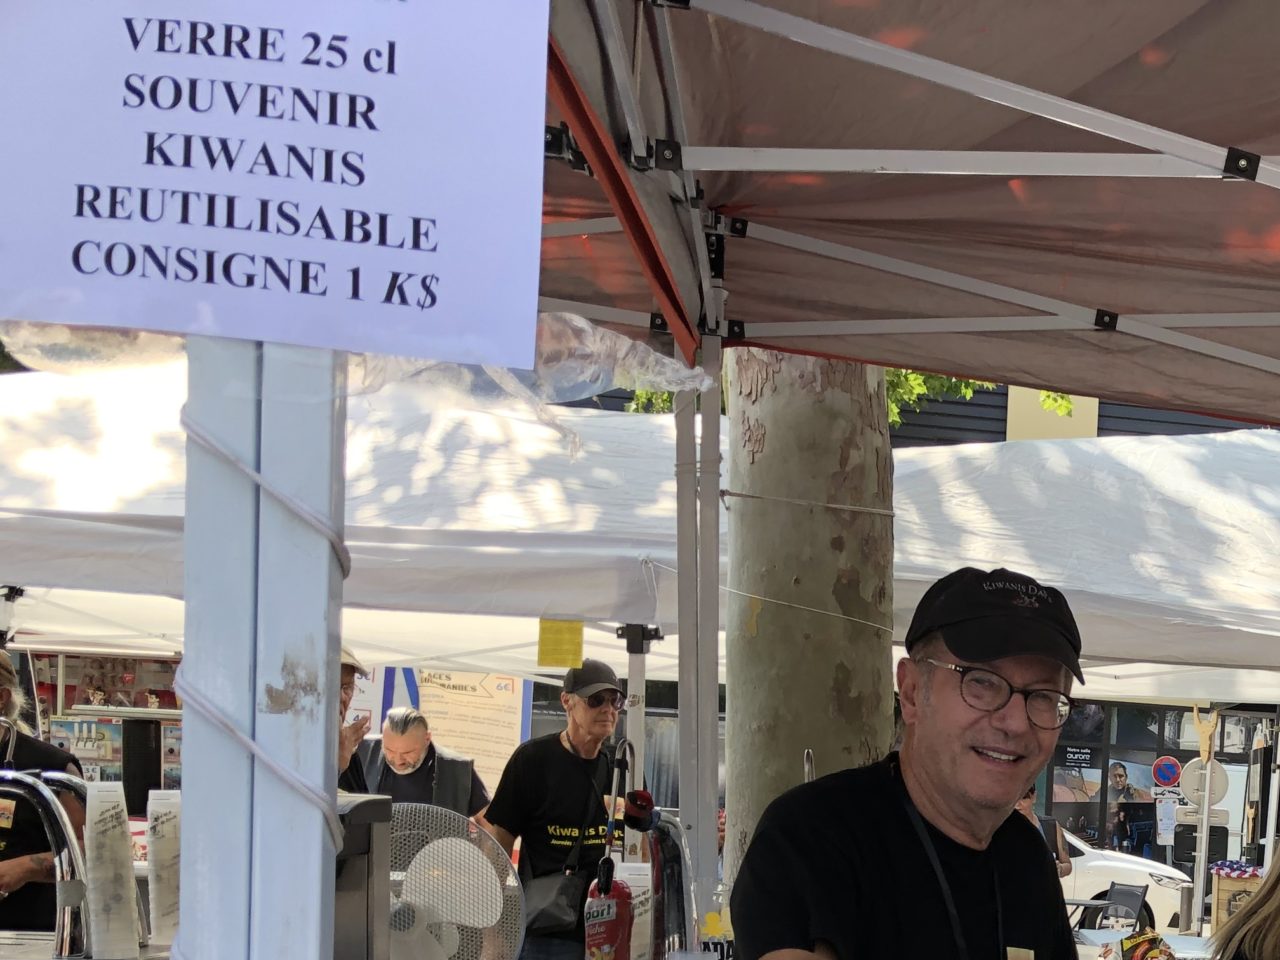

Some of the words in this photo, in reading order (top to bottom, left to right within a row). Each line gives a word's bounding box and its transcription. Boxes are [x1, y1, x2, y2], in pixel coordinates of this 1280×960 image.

[123, 17, 285, 62] VERRE
[301, 32, 348, 69] 25
[363, 40, 397, 75] cl
[122, 73, 379, 131] SOUVENIR
[143, 131, 365, 187] KIWANIS
[74, 184, 438, 252] REUTILISABLE
[72, 240, 327, 297] CONSIGNE
[347, 266, 365, 301] 1
[382, 271, 440, 311] K$
[547, 825, 596, 837] Kiwais
